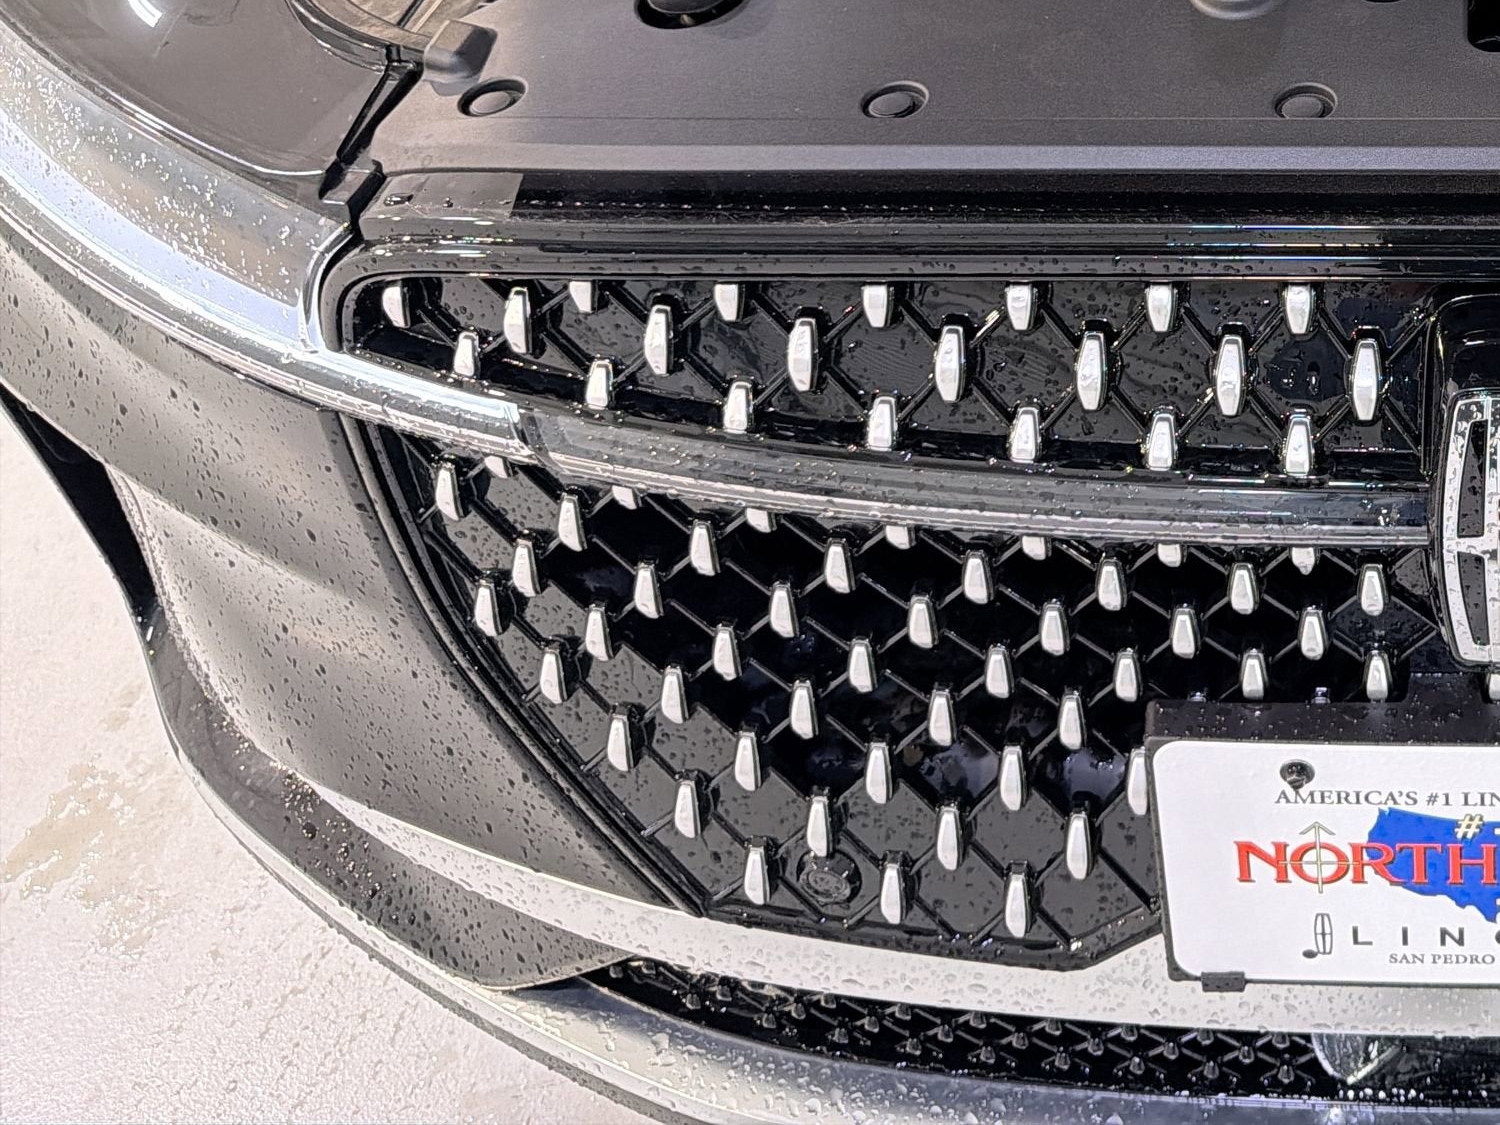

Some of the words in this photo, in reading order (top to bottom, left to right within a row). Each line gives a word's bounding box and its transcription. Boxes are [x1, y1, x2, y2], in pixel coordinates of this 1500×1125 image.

[1274, 789, 1419, 806] AMERICA'S
[1426, 792, 1453, 806] #1
[1233, 840, 1498, 885] NORTH
[1388, 952, 1425, 965] SAN
[1431, 953, 1496, 965] PEDRO
